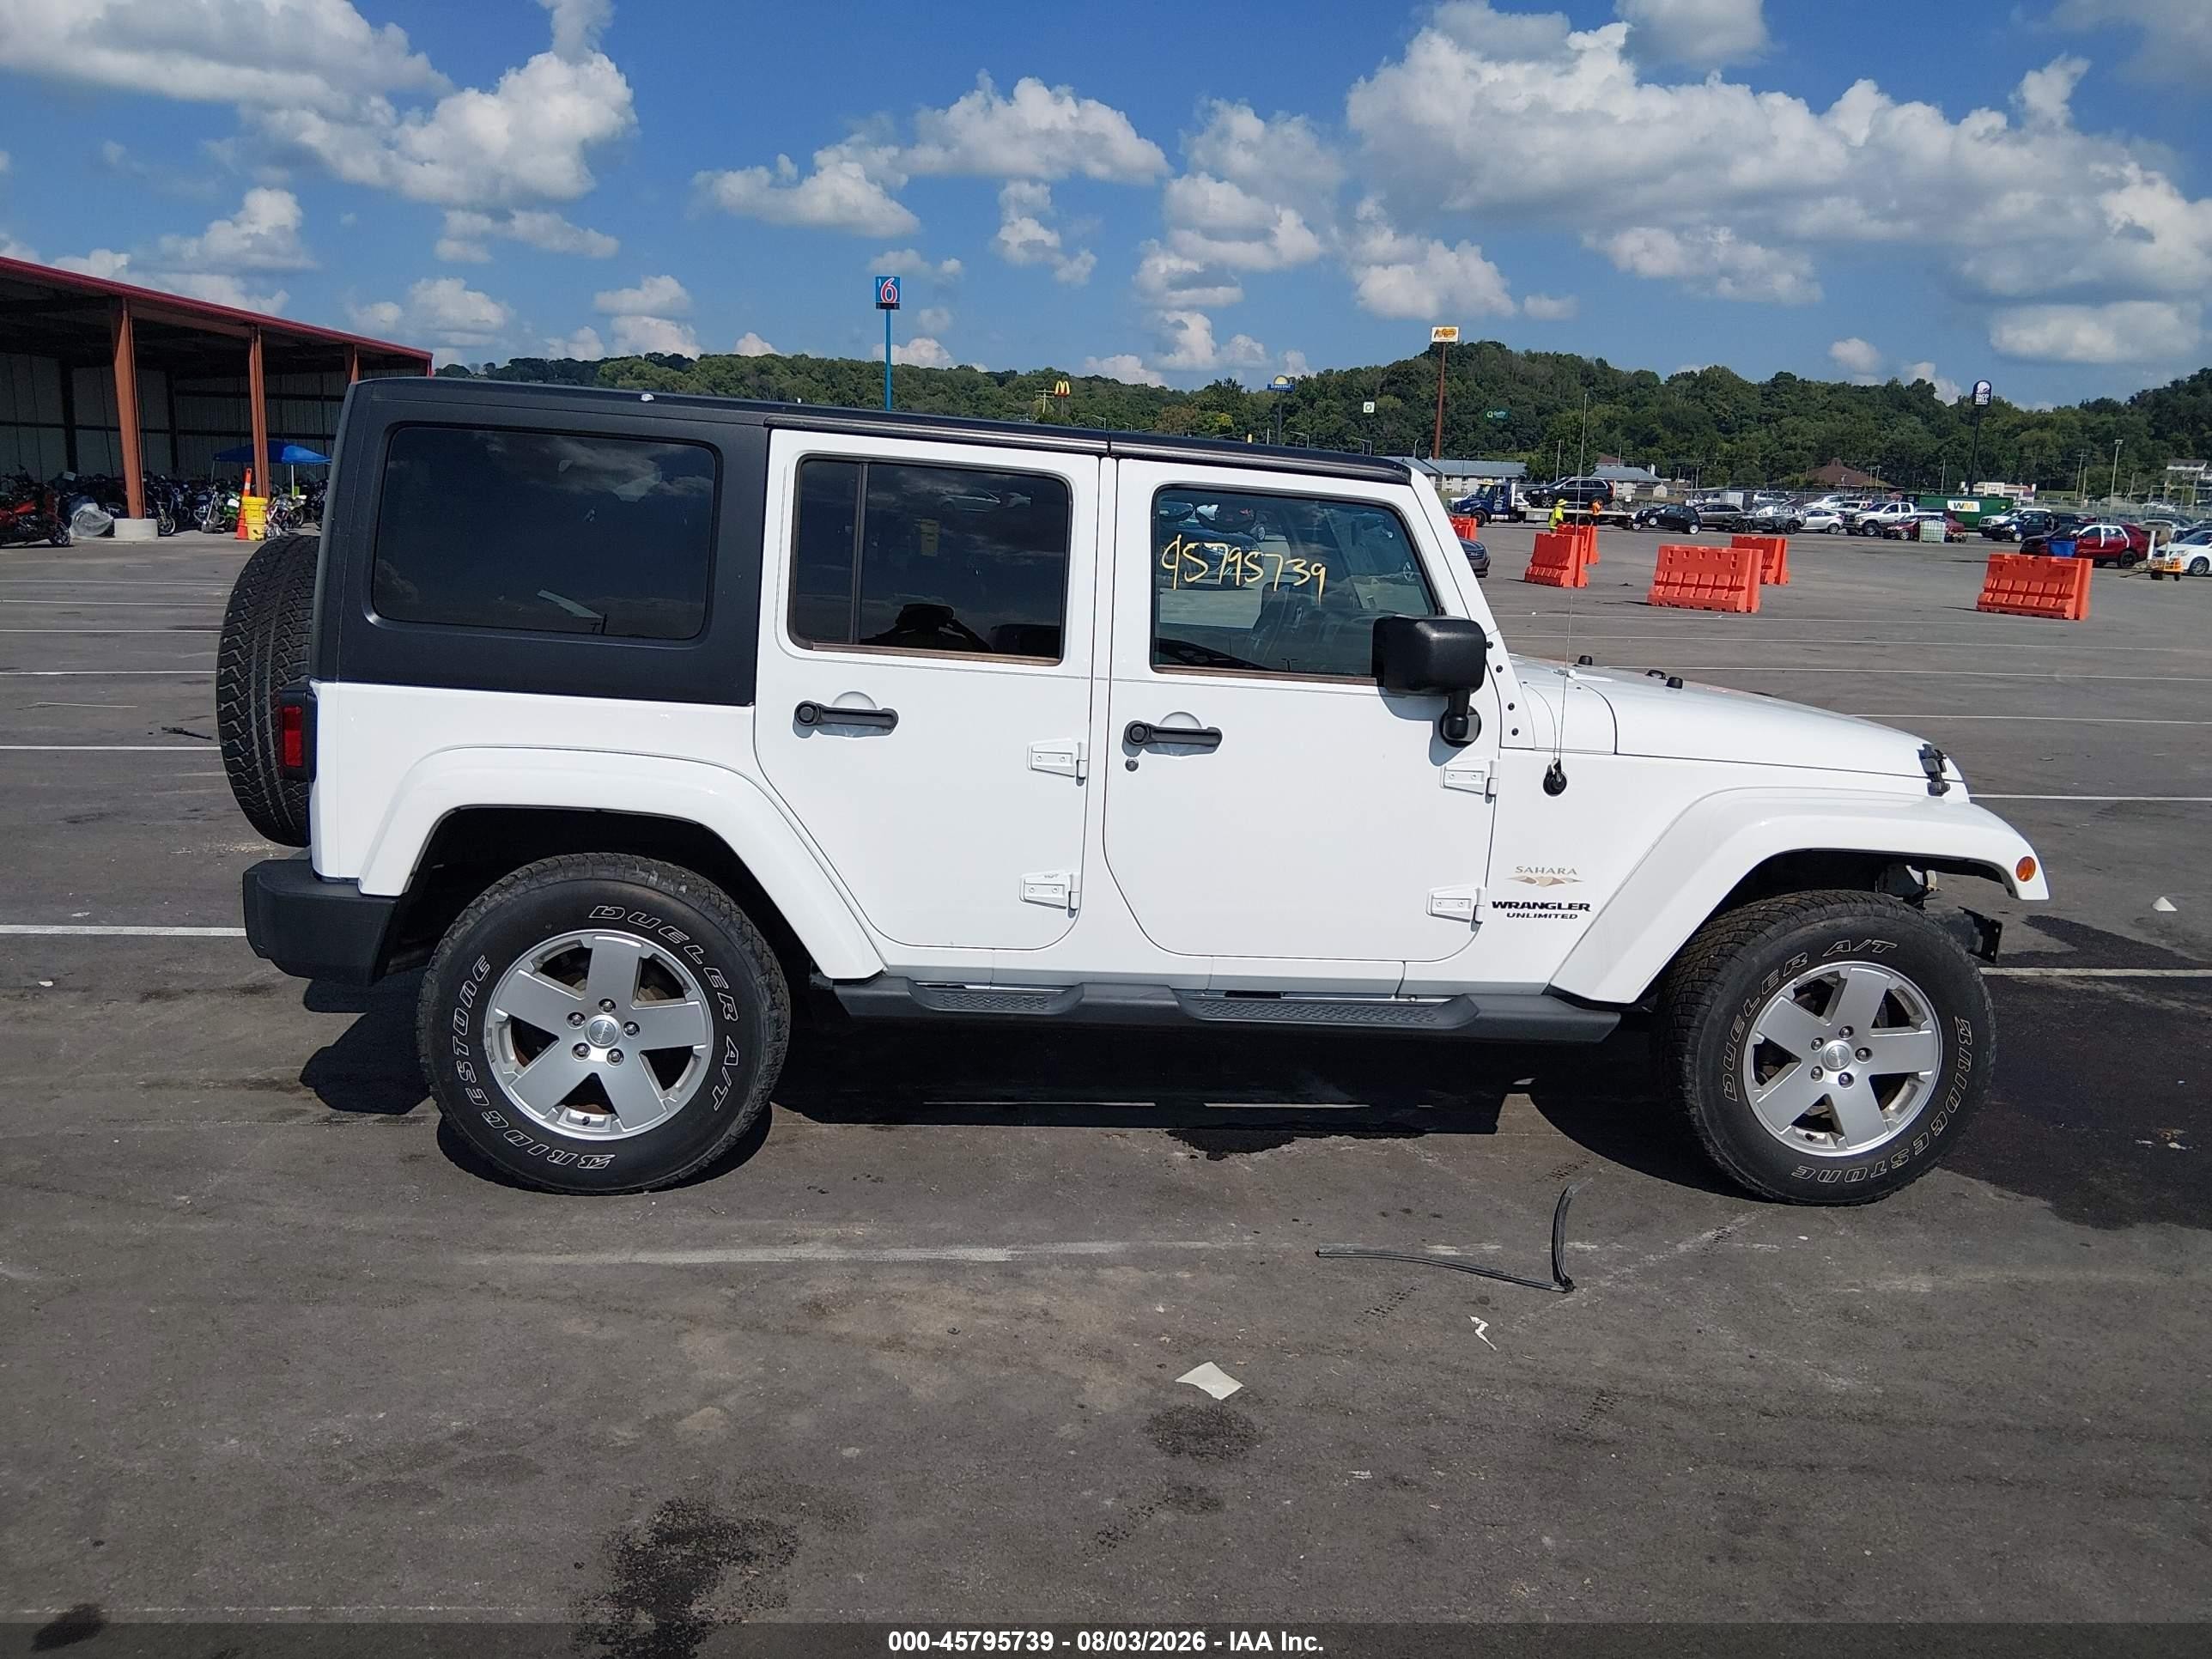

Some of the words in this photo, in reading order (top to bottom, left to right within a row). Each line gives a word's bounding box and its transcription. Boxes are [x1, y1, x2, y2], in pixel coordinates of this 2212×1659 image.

[880, 277, 897, 303] 6
[1161, 534, 1327, 605] 45795739
[1492, 901, 1592, 912] WRANGLER
[1515, 866, 1577, 876] SAHARA
[453, 955, 617, 1170] BRIDGESTONE
[589, 905, 739, 1022] DUELER
[713, 1035, 739, 1111] A/T
[1722, 951, 1808, 1102] DUELER
[1821, 939, 1898, 957] A/T
[1791, 1016, 1973, 1184] BRIDGESTONE
